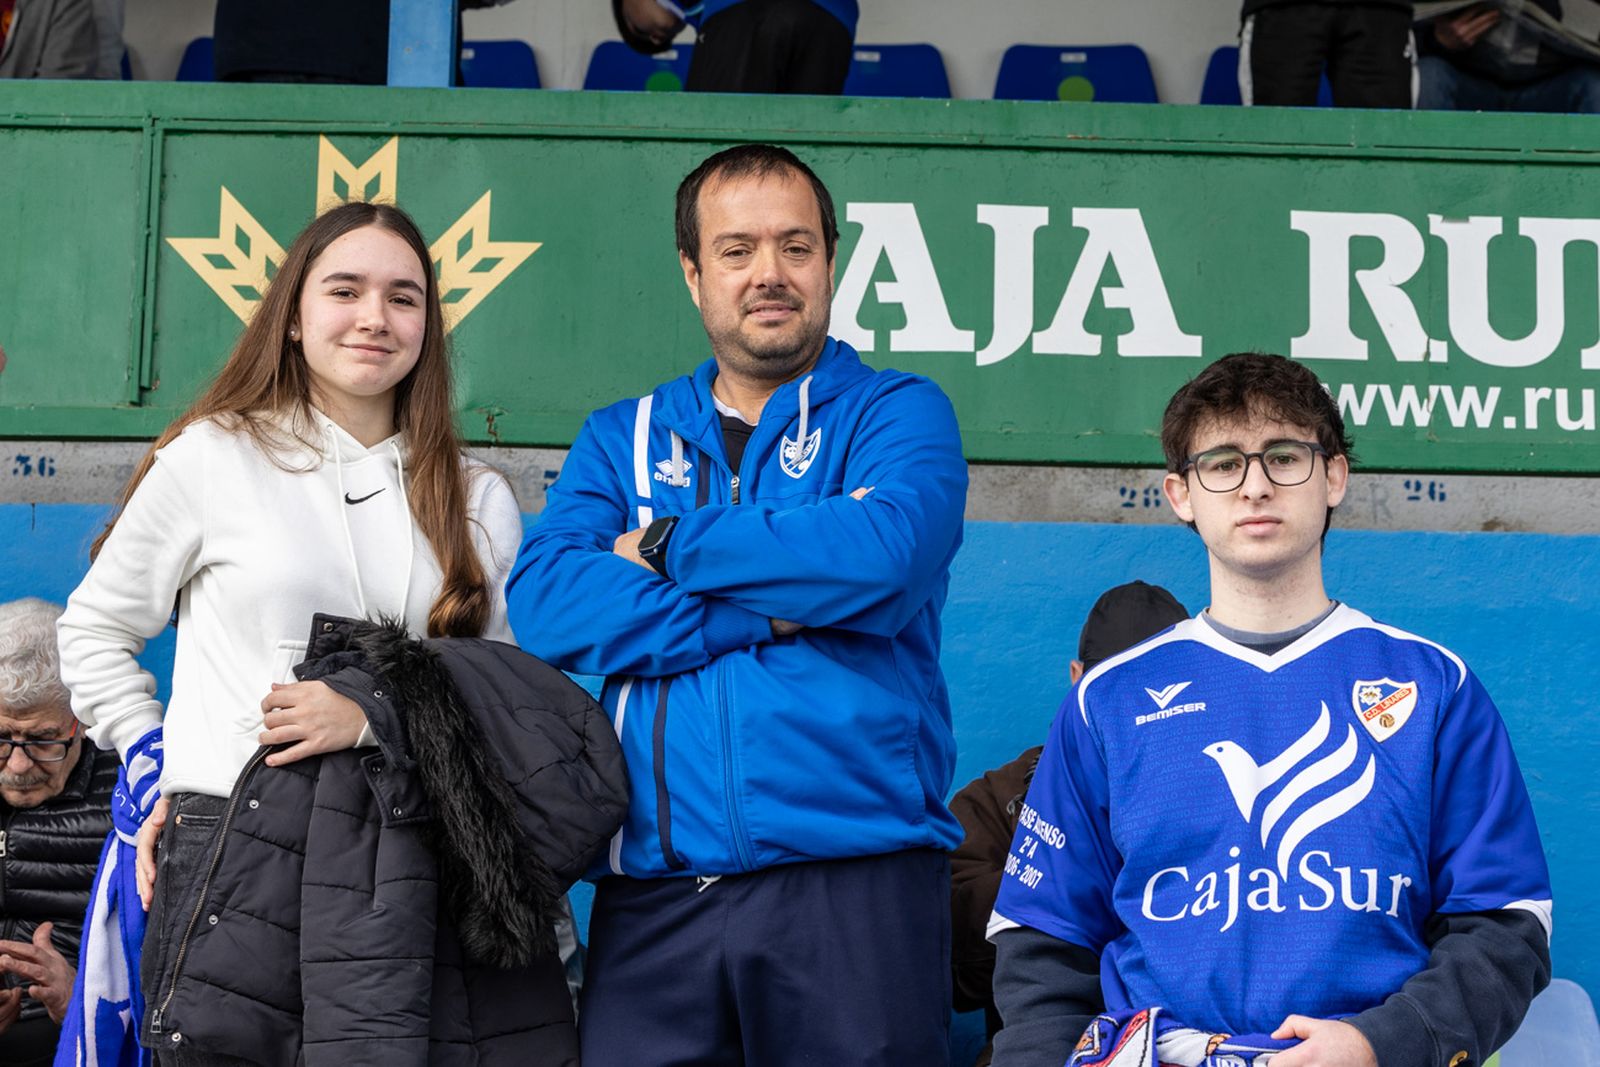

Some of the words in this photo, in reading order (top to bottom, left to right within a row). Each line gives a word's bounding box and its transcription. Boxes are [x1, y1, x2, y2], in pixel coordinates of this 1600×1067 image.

[1290, 210, 1600, 369] RU
[1404, 480, 1446, 502] 26
[1141, 846, 1412, 933] CajaSur
